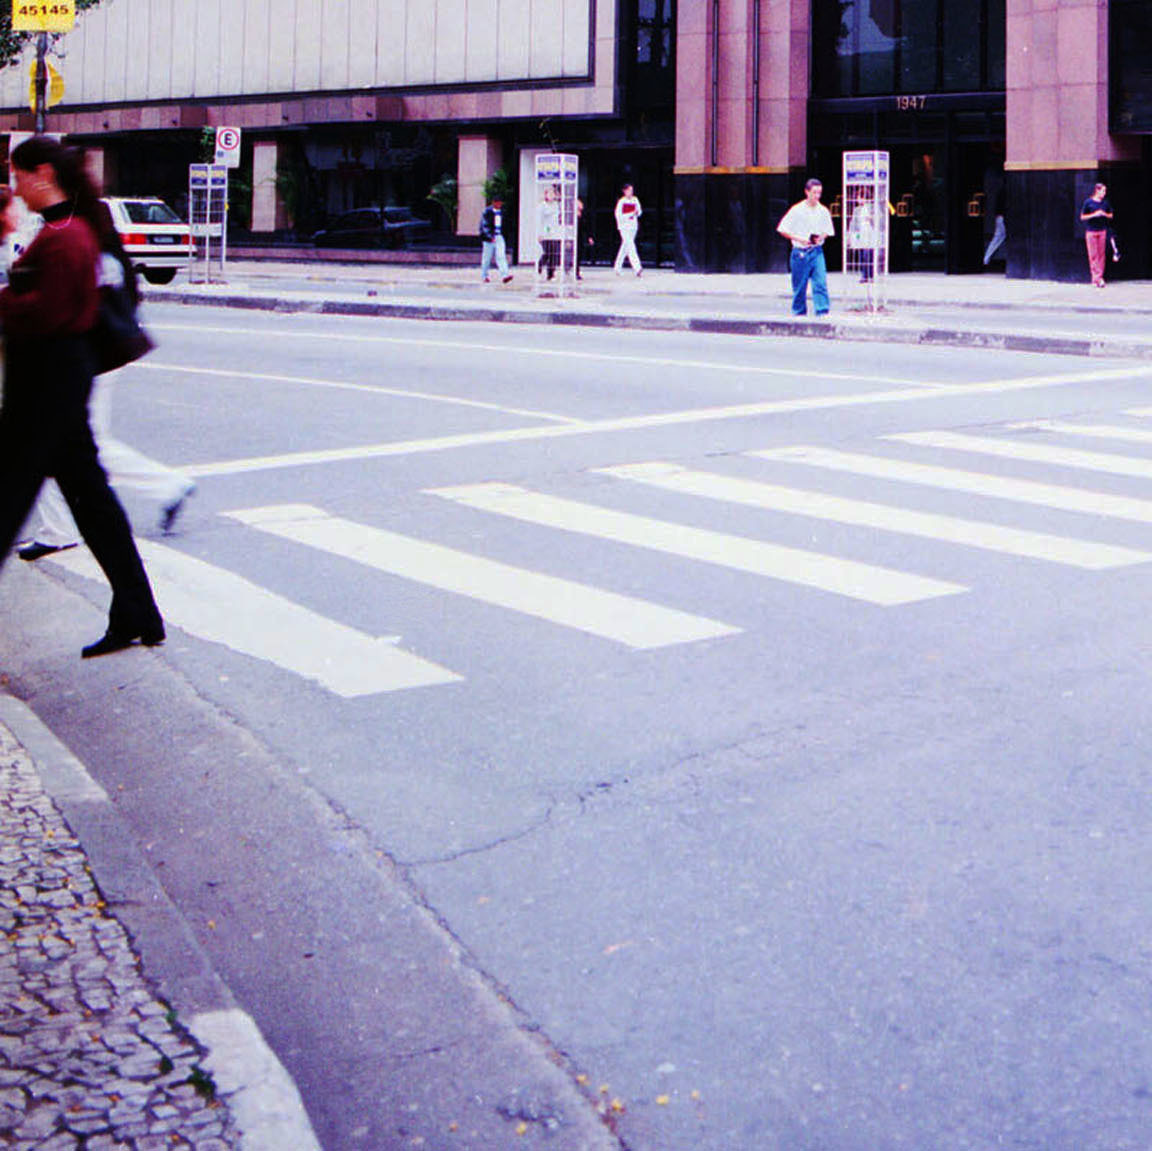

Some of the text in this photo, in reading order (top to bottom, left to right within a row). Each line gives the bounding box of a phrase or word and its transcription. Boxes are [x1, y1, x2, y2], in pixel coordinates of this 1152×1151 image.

[18, 5, 69, 16] 45145
[896, 95, 927, 111] 1947
[224, 133, 233, 146] E
